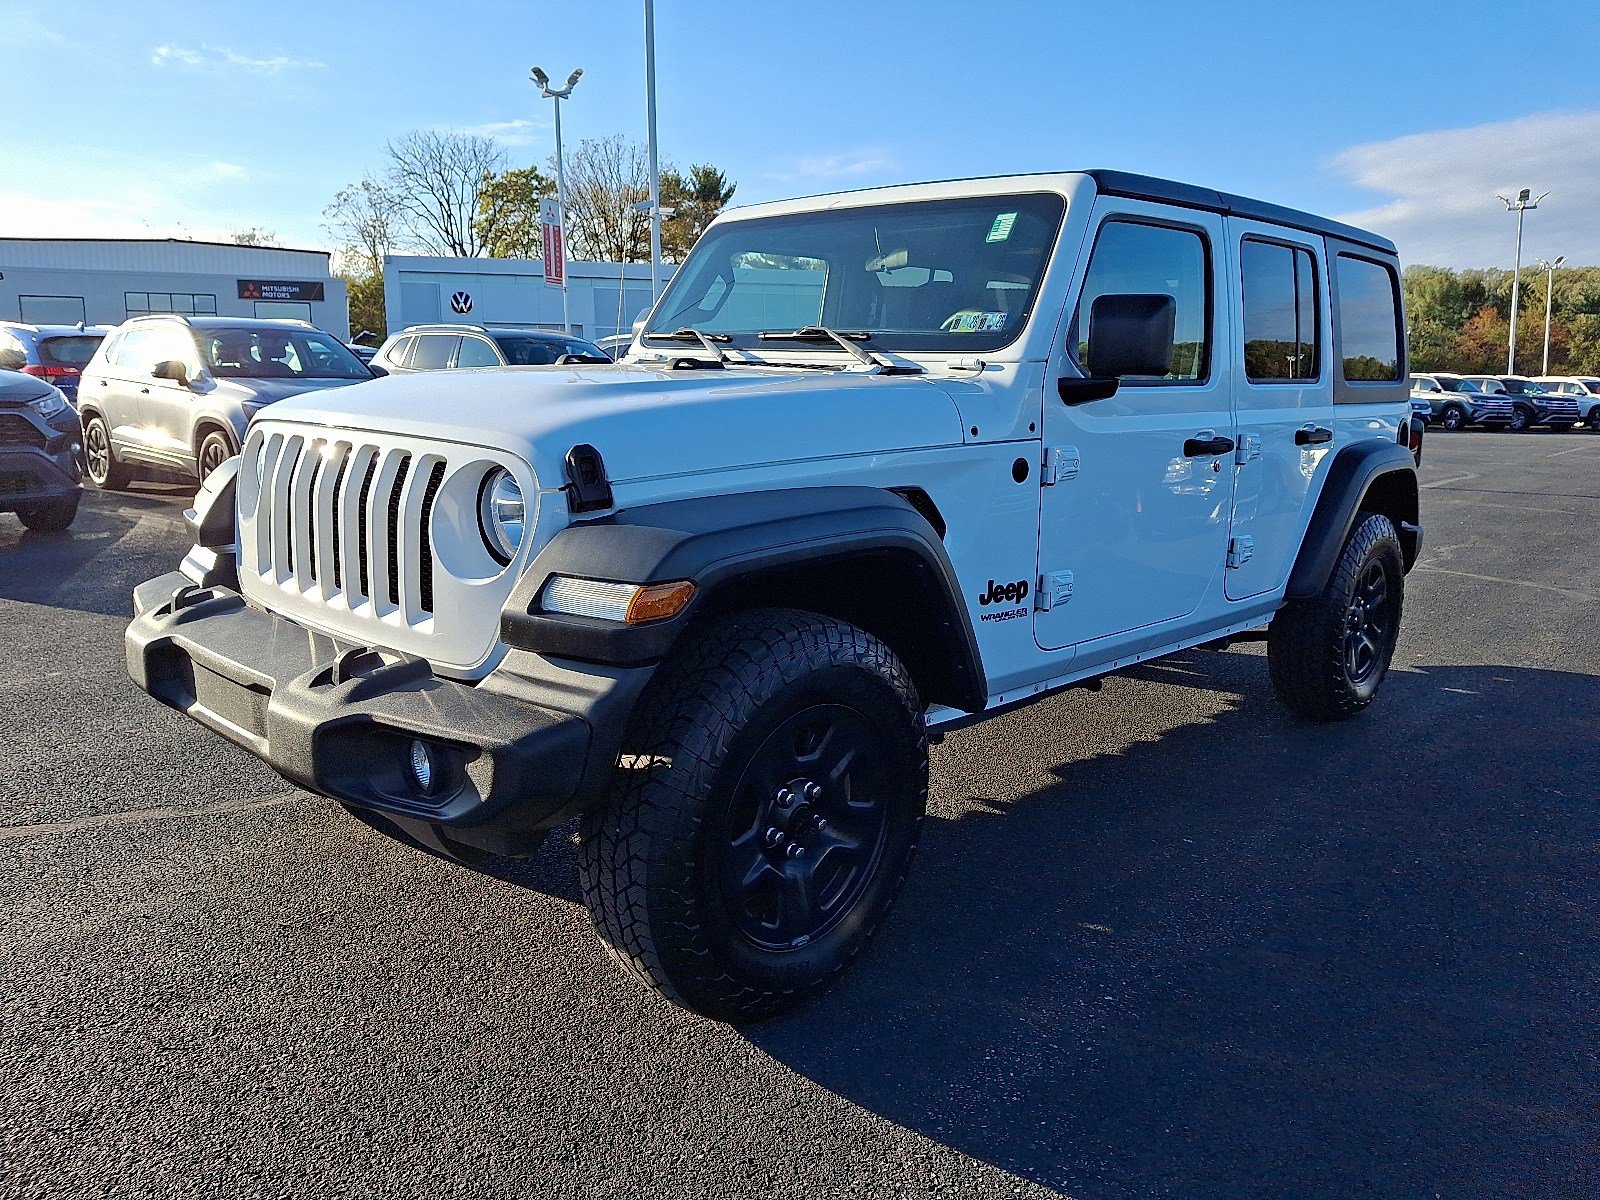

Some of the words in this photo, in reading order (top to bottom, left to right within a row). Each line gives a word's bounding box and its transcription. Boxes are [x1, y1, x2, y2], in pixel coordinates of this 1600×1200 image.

[261, 285, 300, 293] MITSUBISHI
[979, 579, 1028, 605] Jeep
[980, 607, 1027, 621] WRANGLER
